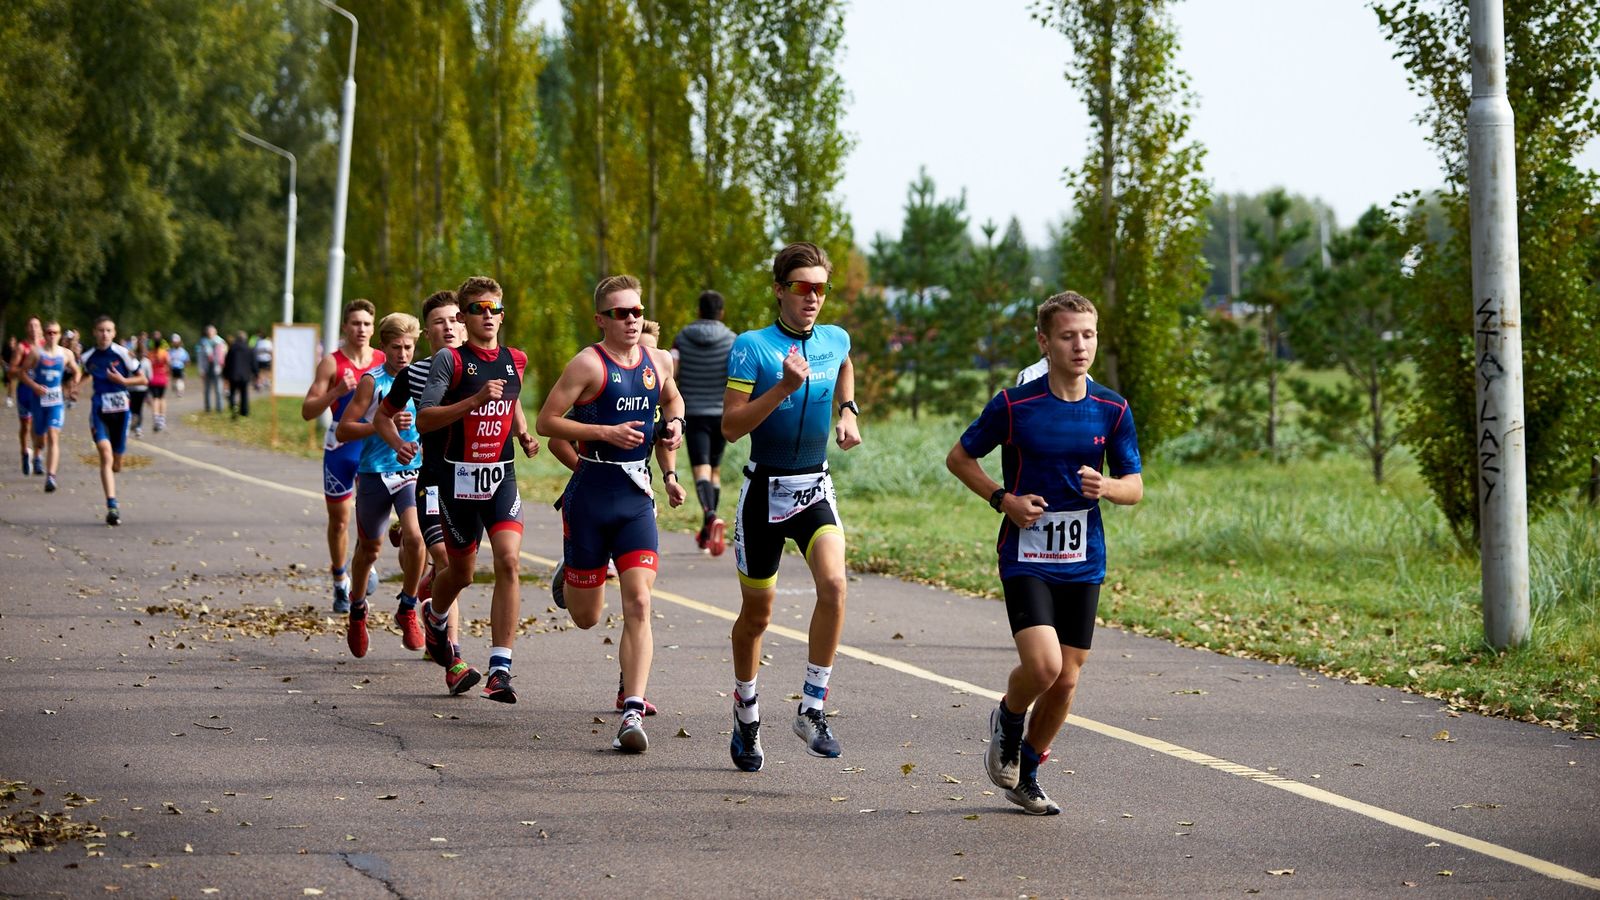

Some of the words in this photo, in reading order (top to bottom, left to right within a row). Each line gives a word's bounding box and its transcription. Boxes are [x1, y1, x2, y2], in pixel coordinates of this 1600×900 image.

[1477, 298, 1504, 392] STAY
[616, 396, 650, 411] CHITA
[476, 421, 502, 437] RUS
[1480, 400, 1500, 505] LAZY
[1042, 519, 1082, 552] 119
